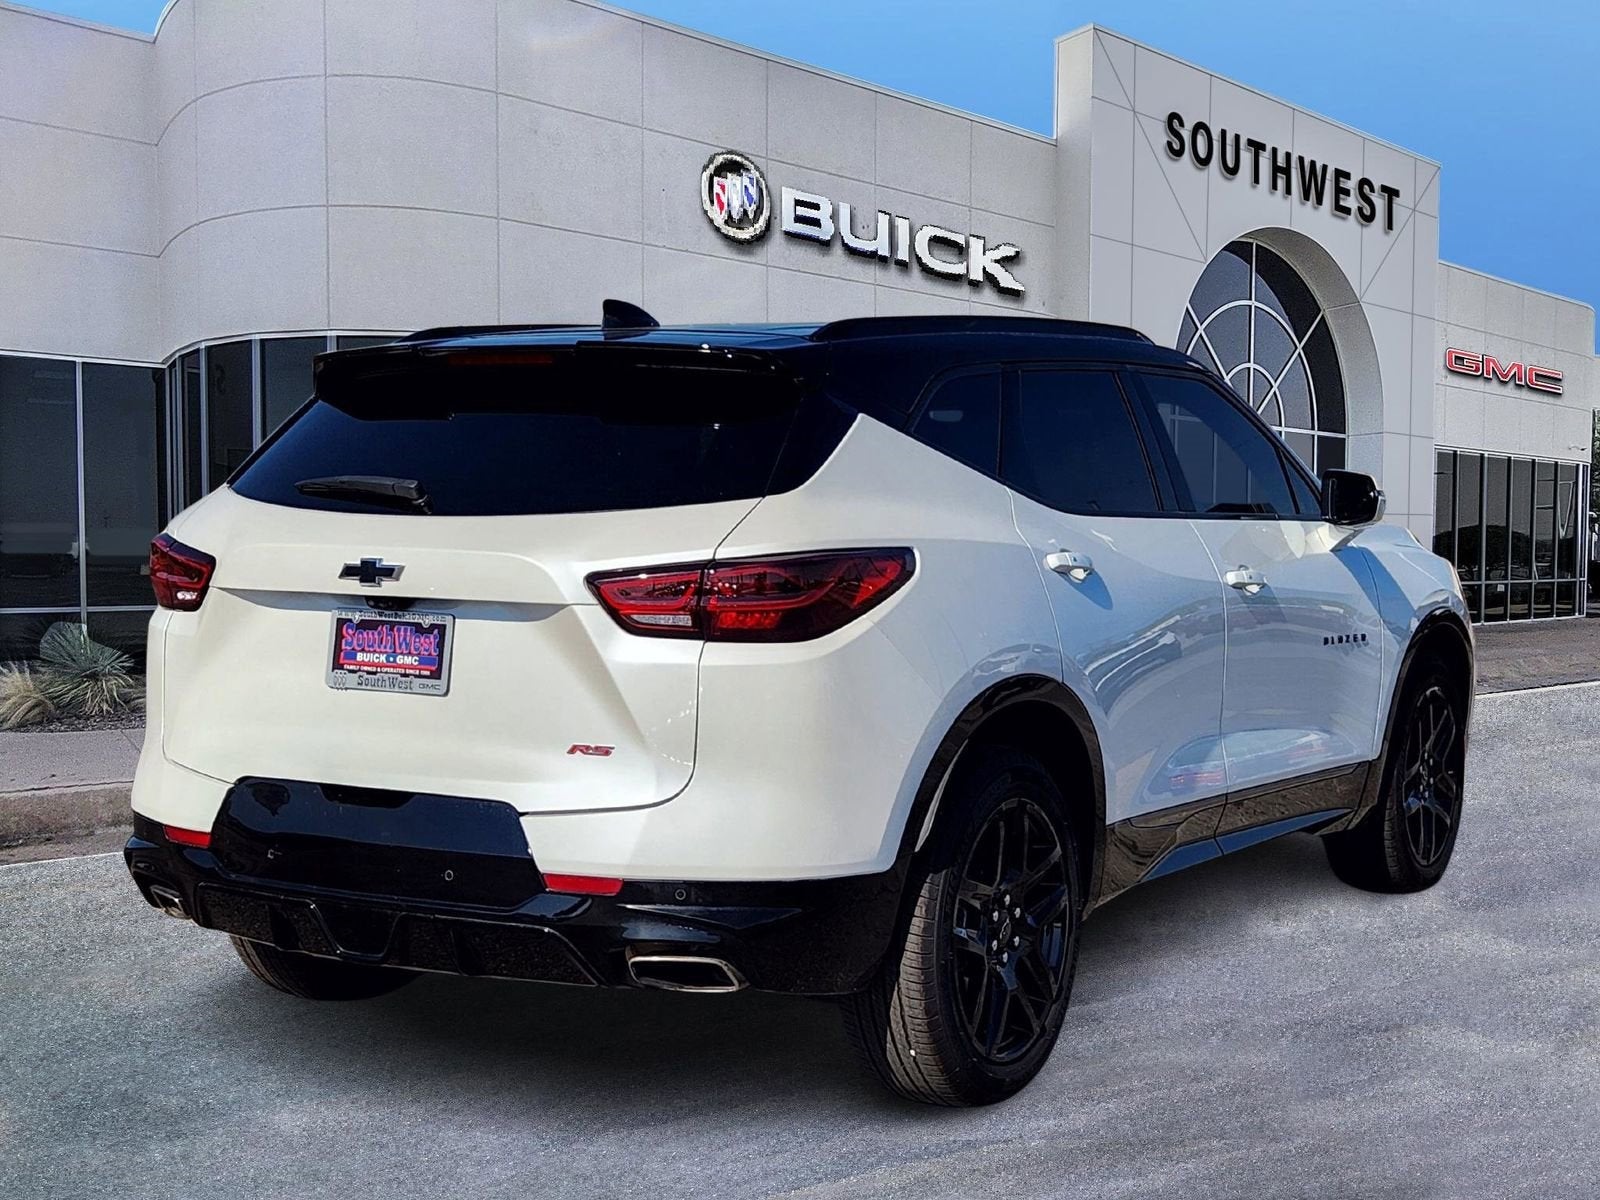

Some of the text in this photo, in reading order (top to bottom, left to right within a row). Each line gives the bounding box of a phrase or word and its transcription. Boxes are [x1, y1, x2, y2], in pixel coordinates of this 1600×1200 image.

[1166, 111, 1401, 232] SOUTHWEST
[781, 186, 1026, 297] BUICK
[1446, 347, 1564, 395] GMC
[356, 651, 420, 665] BUICK GMC
[418, 683, 441, 691] GMC
[566, 744, 615, 756] RS
